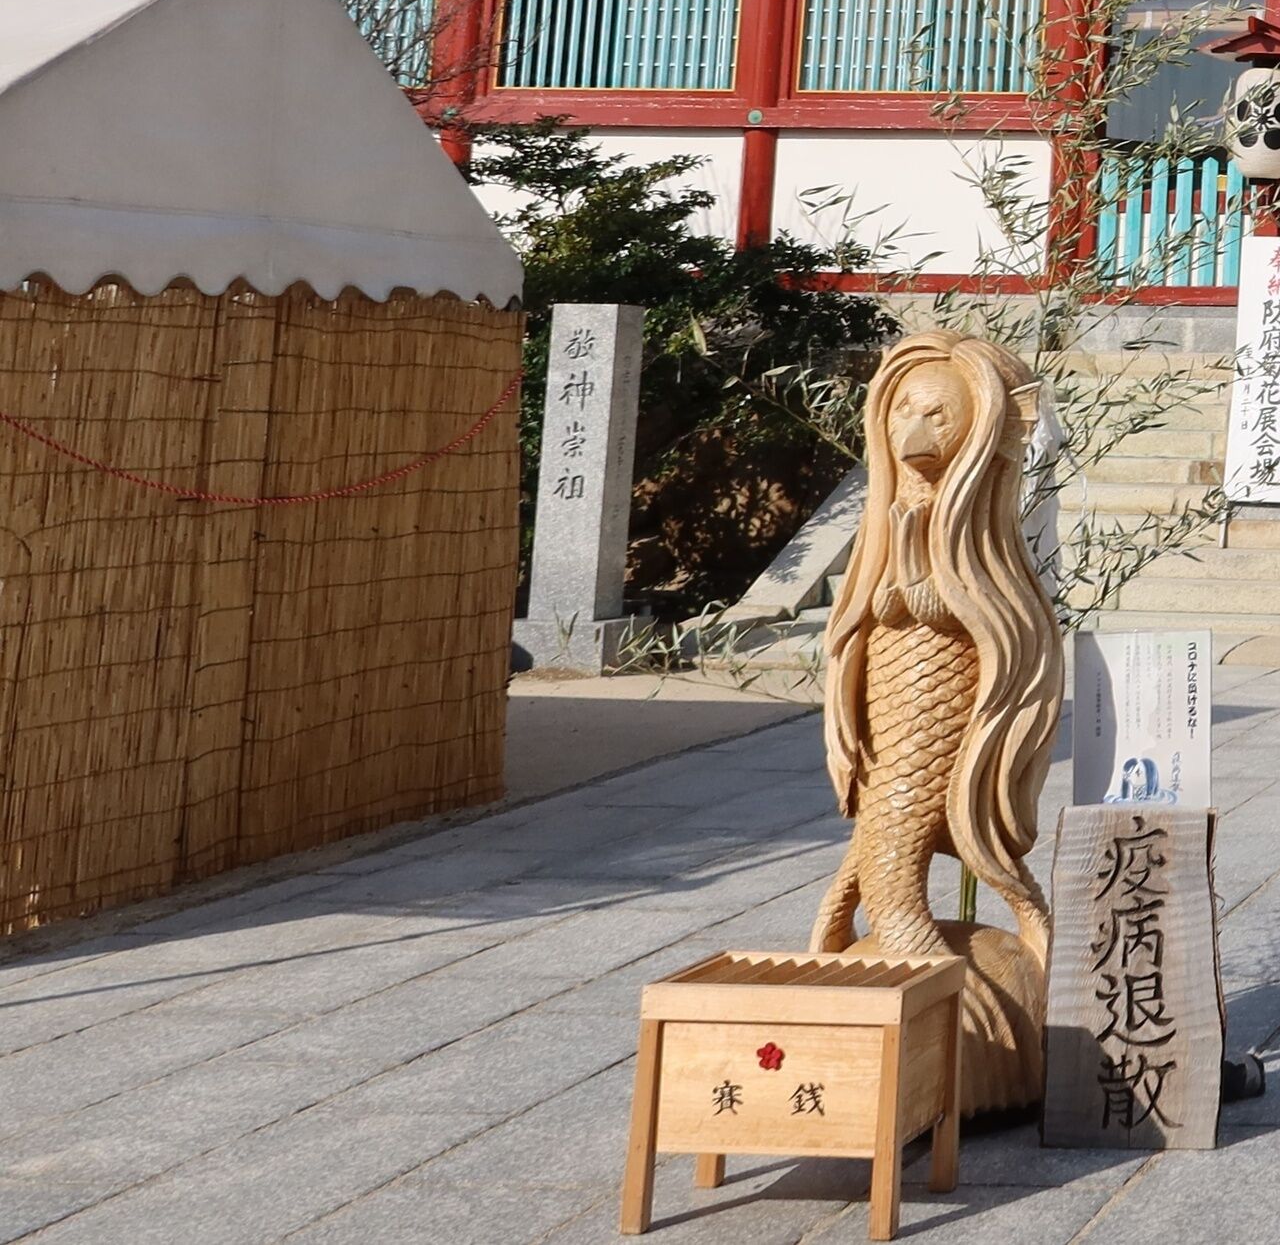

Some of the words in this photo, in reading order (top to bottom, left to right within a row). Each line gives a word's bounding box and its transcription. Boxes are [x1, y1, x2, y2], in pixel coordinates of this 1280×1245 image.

[554, 329, 595, 500] 敬神崇祖
[1091, 816, 1183, 1131] 疫病退散
